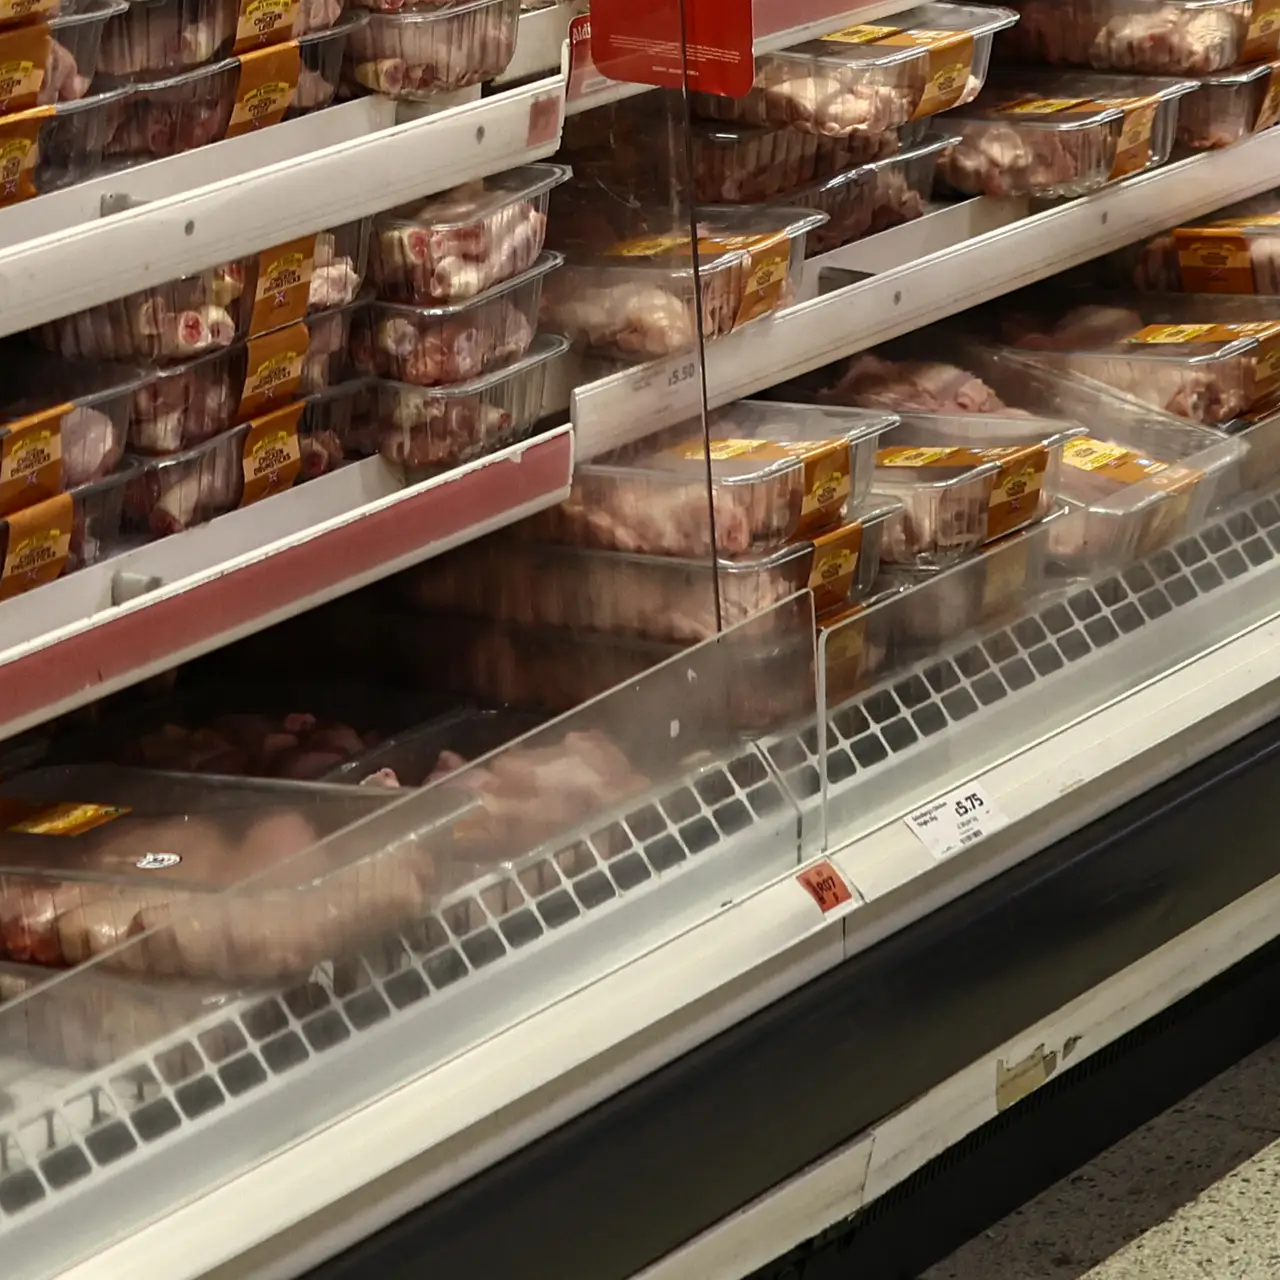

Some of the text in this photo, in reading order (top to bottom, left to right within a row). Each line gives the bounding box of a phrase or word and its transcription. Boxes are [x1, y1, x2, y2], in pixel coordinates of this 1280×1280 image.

[254, 13, 282, 26] CHICKEN
[572, 22, 591, 44] Aldi
[668, 363, 695, 387] £5.50
[955, 793, 984, 817] £5.75
